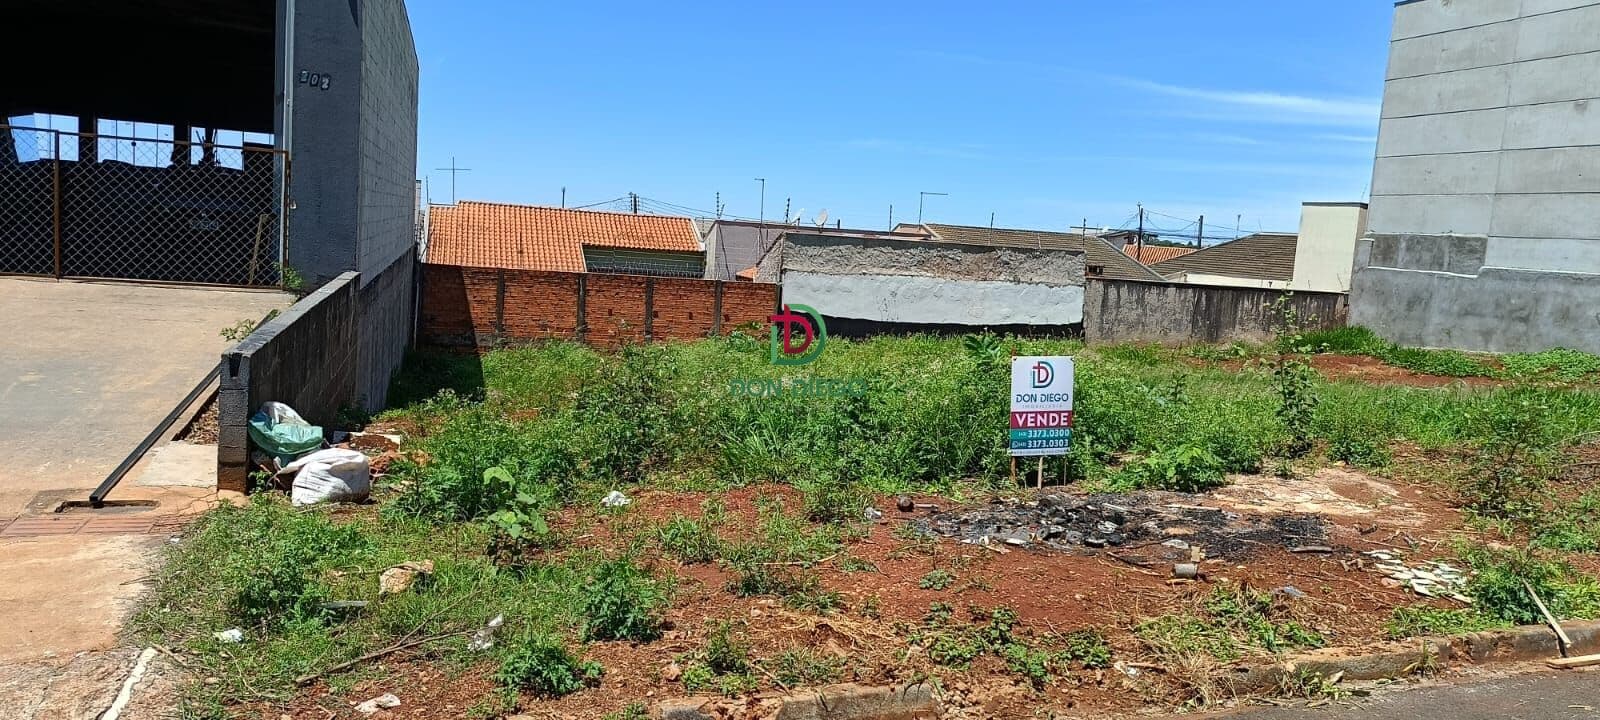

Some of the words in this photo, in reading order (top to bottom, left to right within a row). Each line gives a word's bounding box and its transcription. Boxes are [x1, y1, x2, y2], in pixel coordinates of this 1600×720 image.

[1016, 393, 1037, 403] DON
[1040, 393, 1069, 402] DIEGO
[1015, 413, 1069, 427] VENDE
[1027, 429, 1070, 438] 3373.0300
[1027, 439, 1069, 448] 3373.0303
